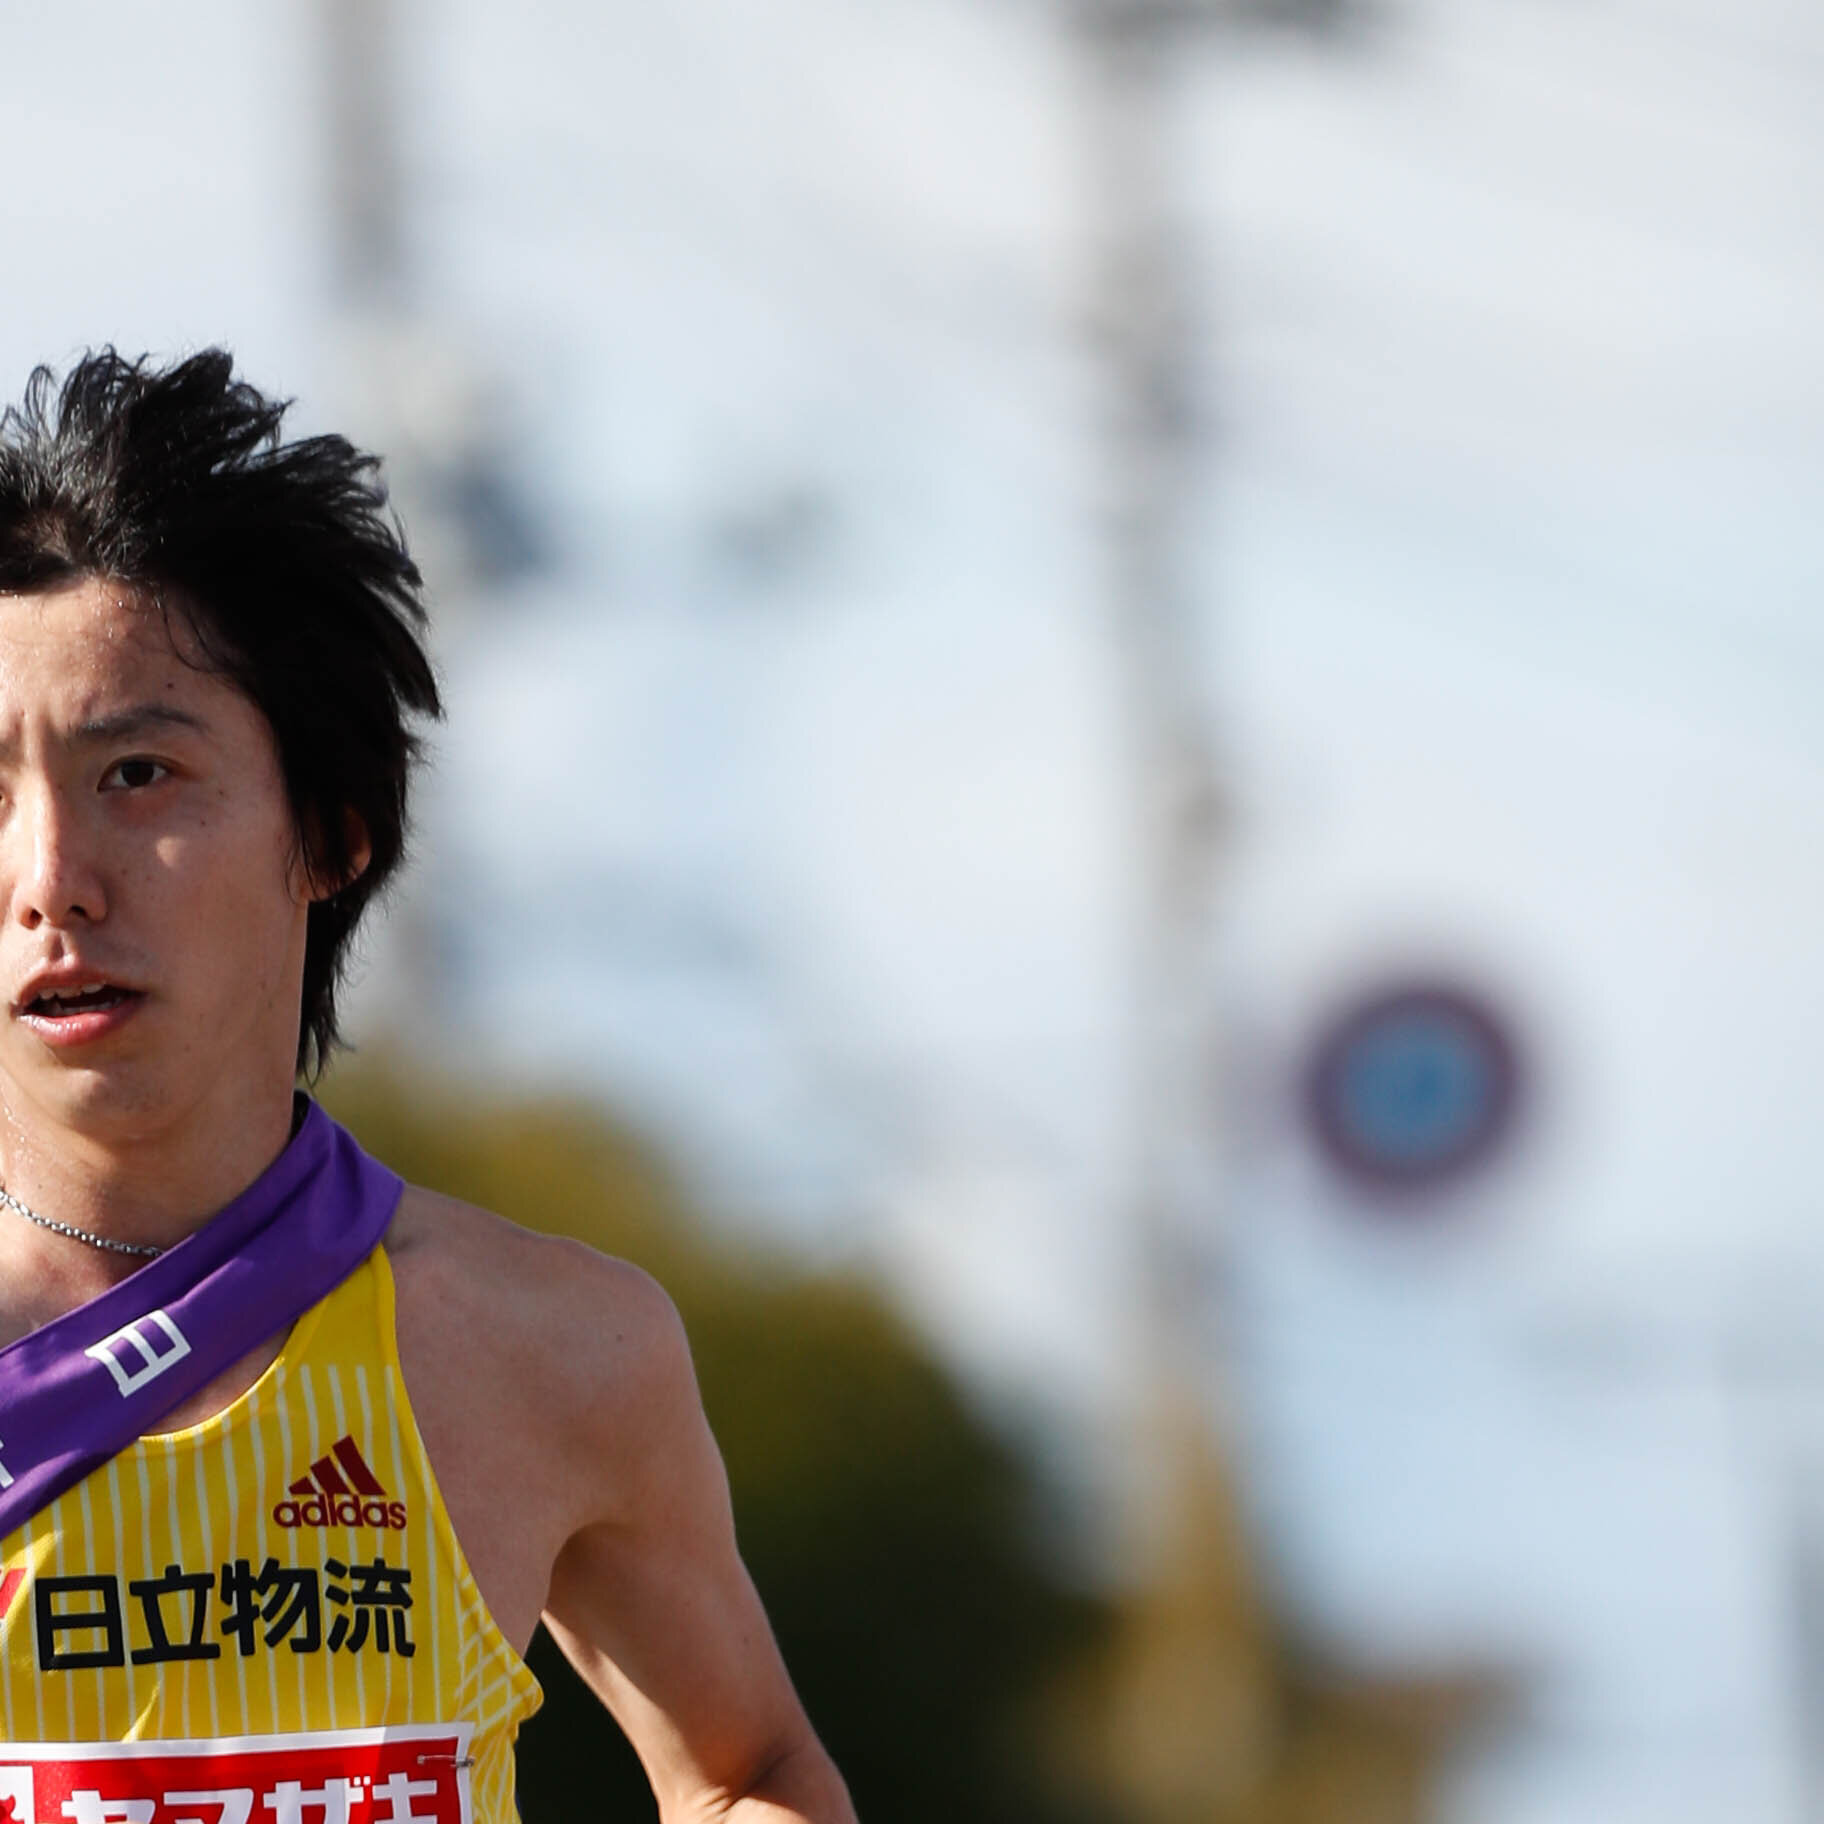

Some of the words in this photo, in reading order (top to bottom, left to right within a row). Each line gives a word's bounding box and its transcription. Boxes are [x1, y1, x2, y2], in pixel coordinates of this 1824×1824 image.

[273, 1493, 407, 1531] adidas
[35, 1557, 416, 1672] 日立物流
